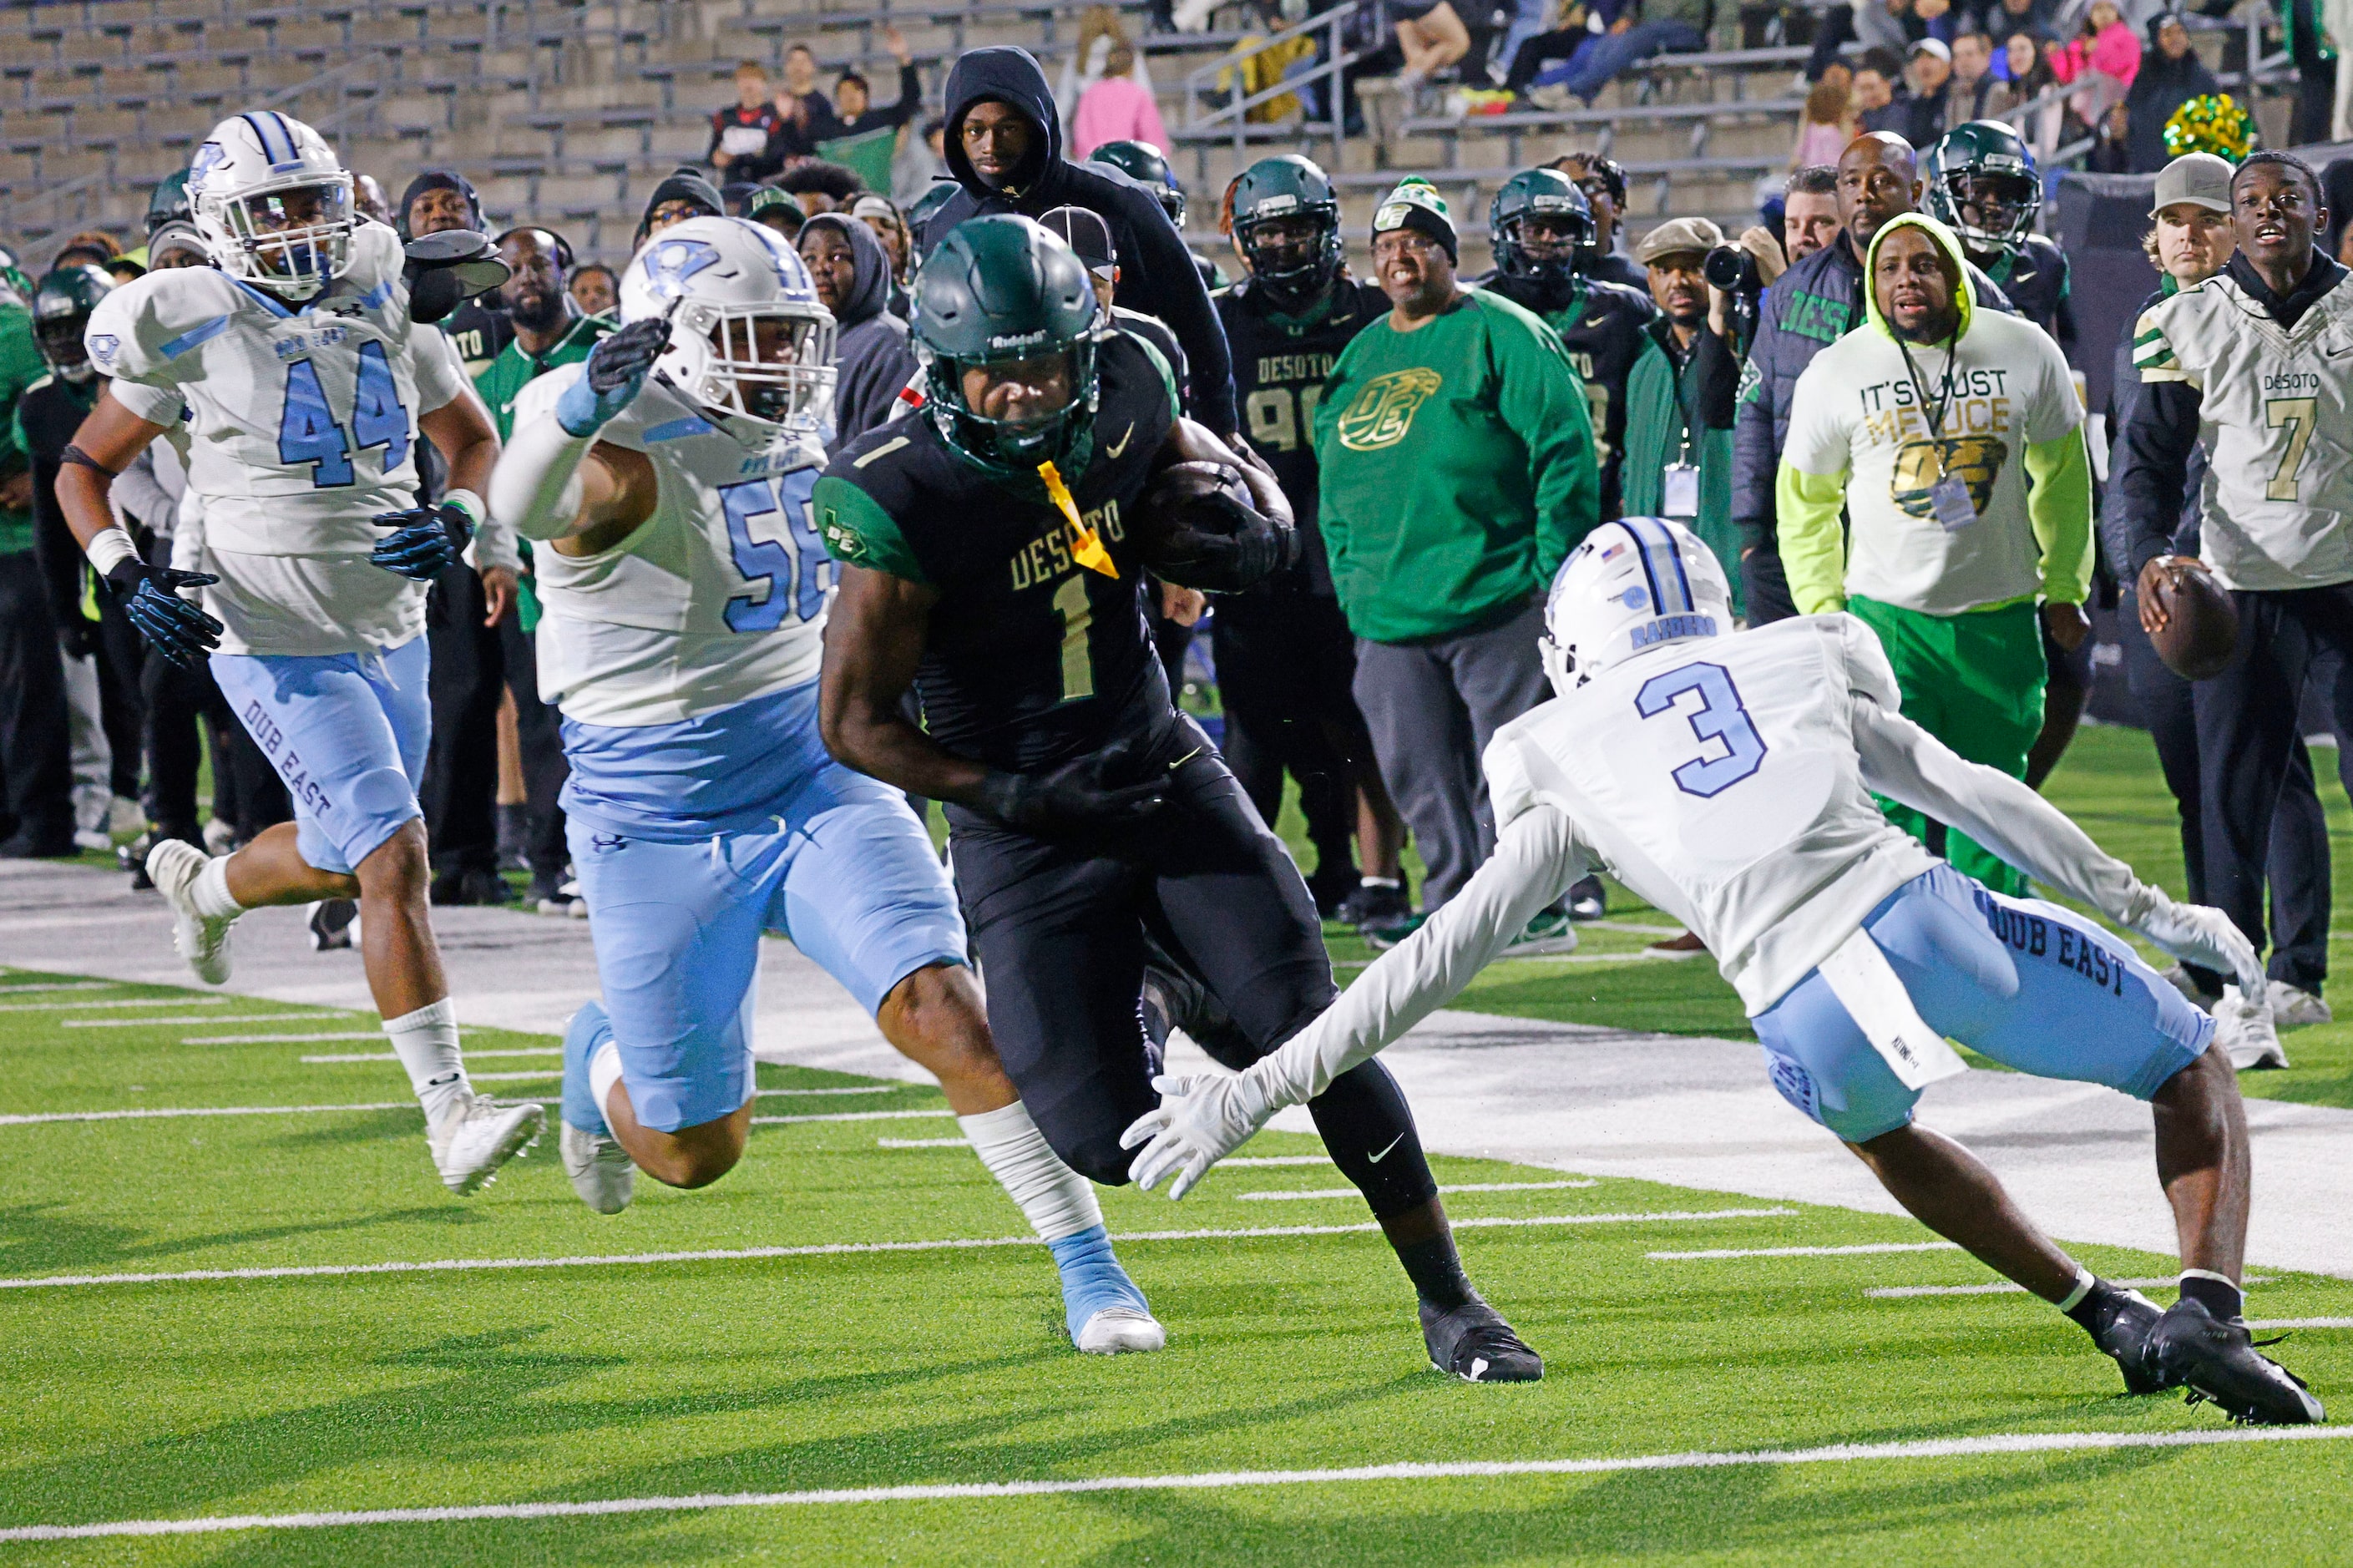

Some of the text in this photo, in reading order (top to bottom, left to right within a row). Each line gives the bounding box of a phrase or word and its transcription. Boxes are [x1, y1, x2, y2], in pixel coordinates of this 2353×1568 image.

[992, 331, 1044, 348] Riddell
[1257, 353, 1333, 383] DESOTO
[2264, 373, 2319, 391] DESOTO
[278, 339, 410, 488] 44
[1860, 379, 1914, 415] IT'S
[2265, 397, 2318, 503] 7
[1052, 573, 1095, 702] 1
[1631, 615, 1718, 650] RAIDERS
[245, 699, 331, 818] DUB EAST
[1634, 661, 1769, 798] 3
[1990, 904, 2126, 996] DUB EAST
